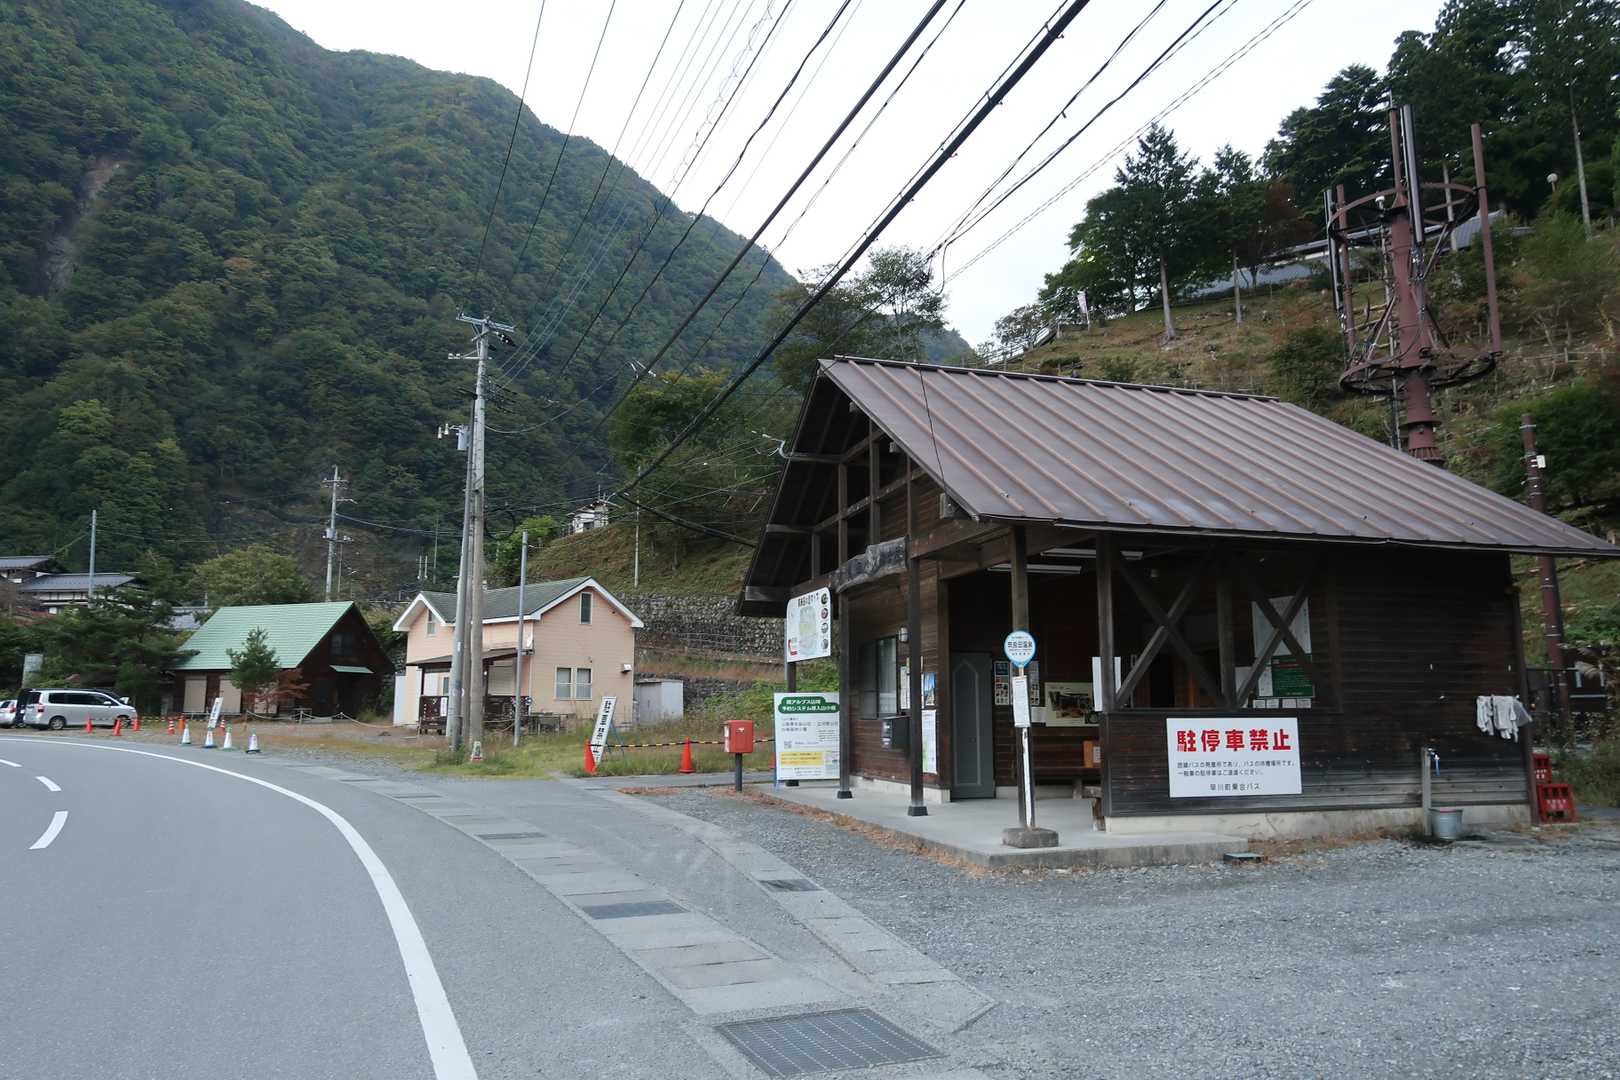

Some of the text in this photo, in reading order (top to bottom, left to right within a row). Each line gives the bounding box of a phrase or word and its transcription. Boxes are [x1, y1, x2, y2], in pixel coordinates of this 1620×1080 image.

[1176, 729, 1291, 752] 駐停車禁止
[1209, 782, 1261, 791] 早川町乗合バス
